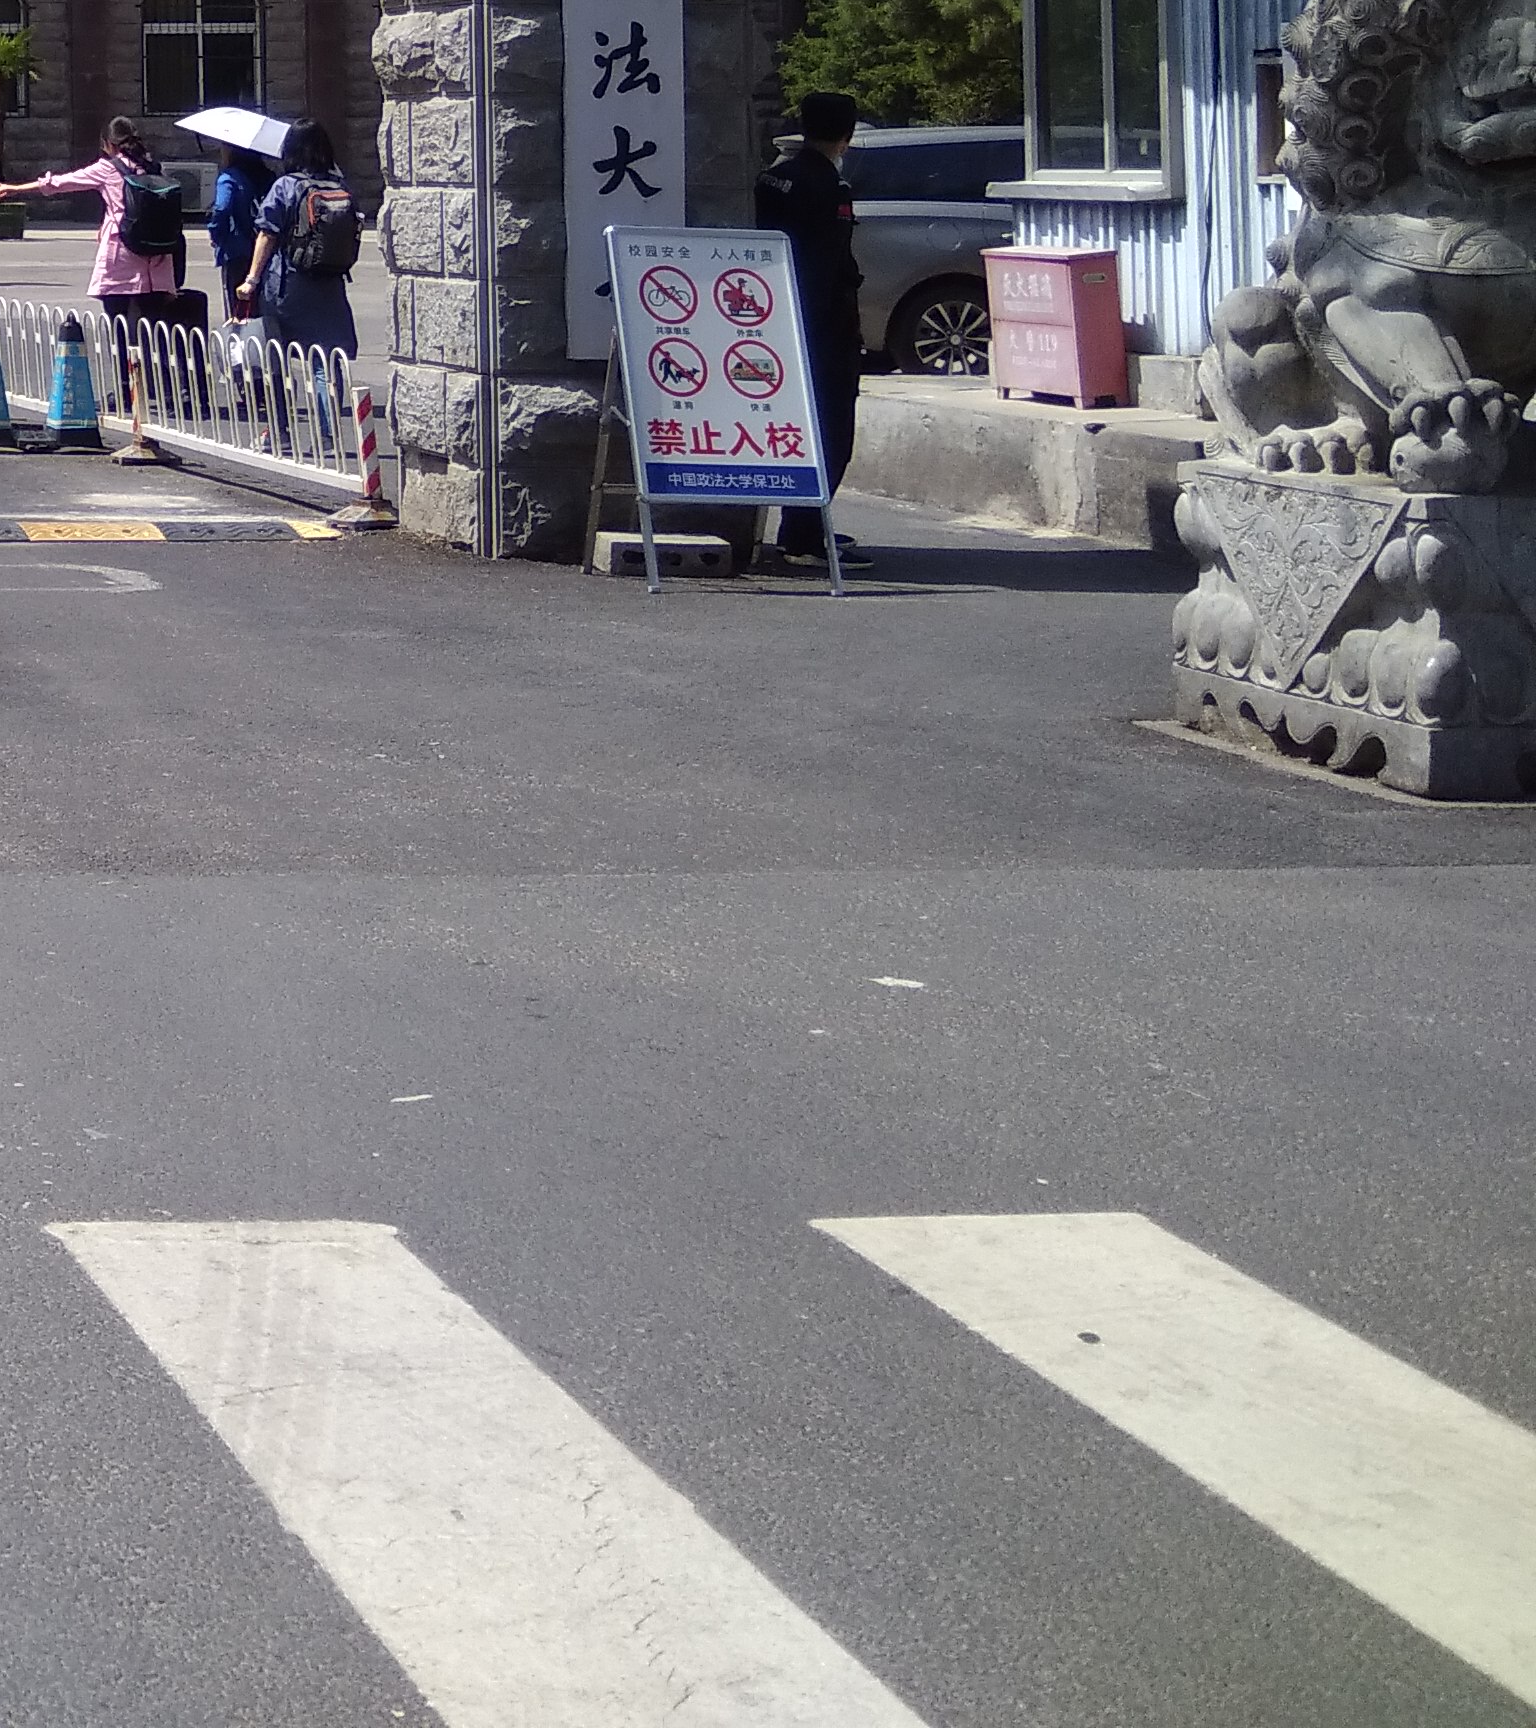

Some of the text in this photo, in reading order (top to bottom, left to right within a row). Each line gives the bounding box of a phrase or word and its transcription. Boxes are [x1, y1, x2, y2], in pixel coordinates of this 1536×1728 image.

[628, 244, 774, 262] 校园安全 人人有责
[647, 419, 806, 459] 禁止入校
[668, 472, 796, 490] 中国政法大学保卫处
